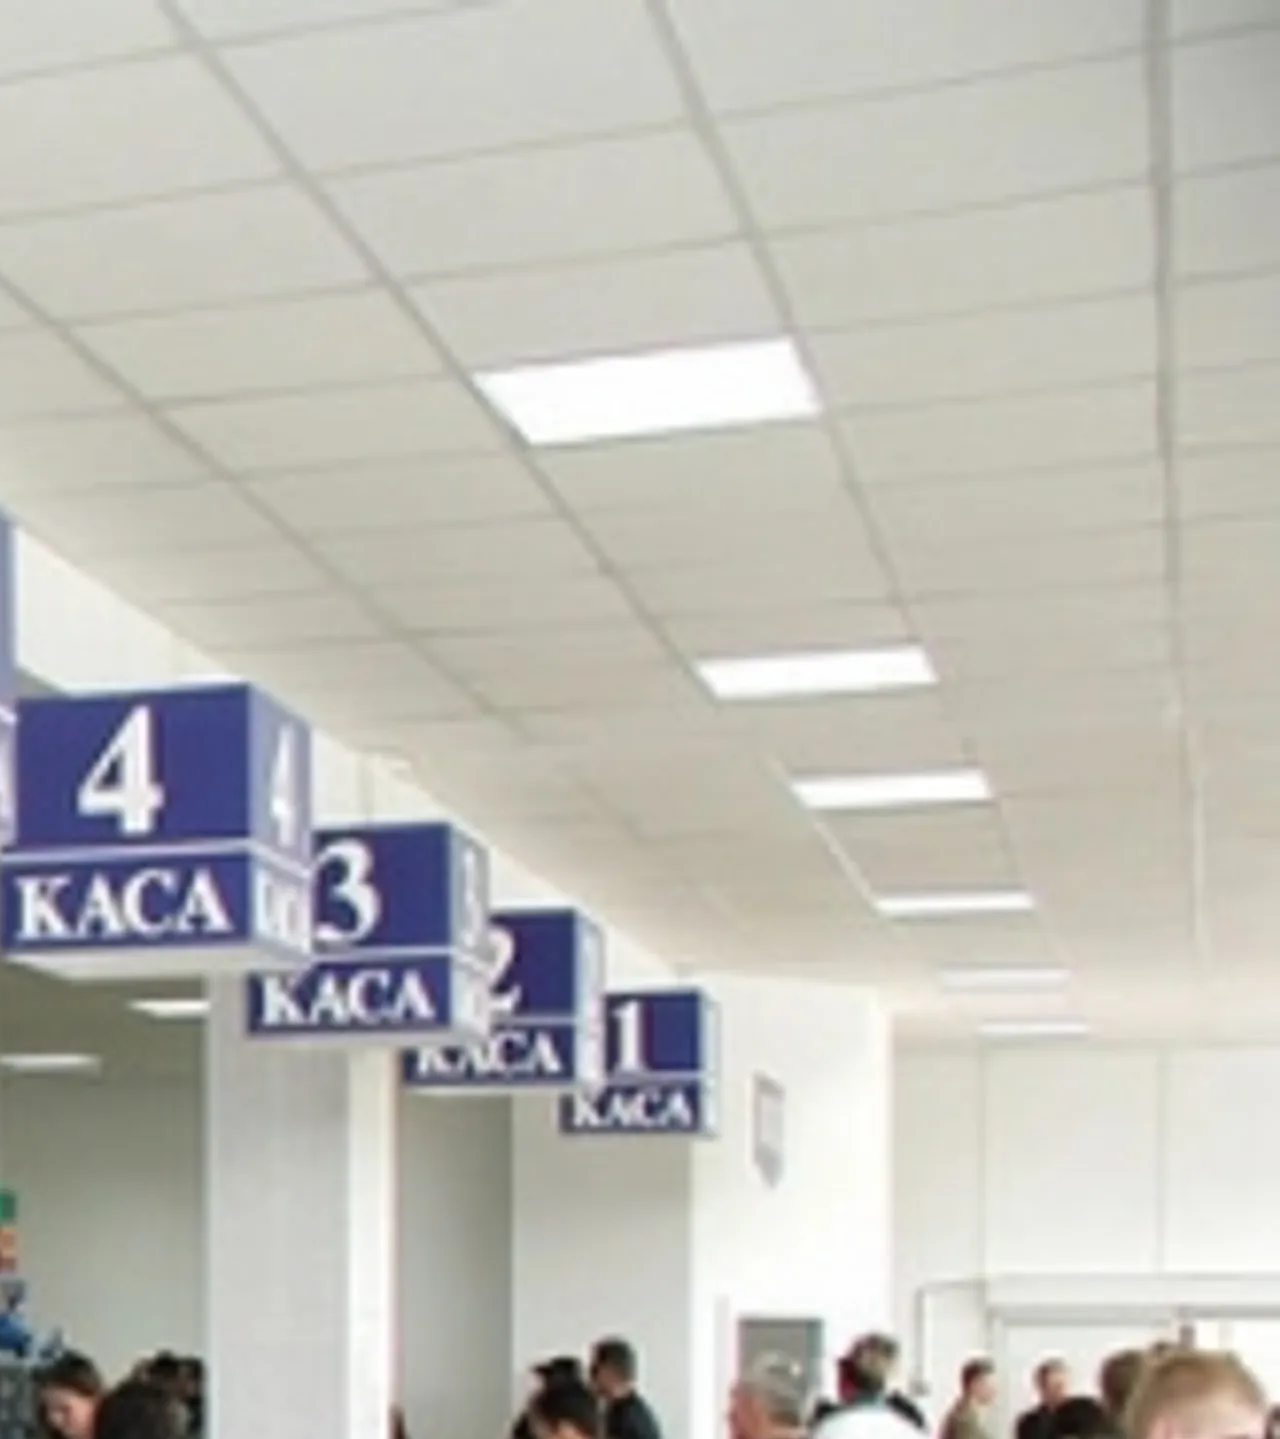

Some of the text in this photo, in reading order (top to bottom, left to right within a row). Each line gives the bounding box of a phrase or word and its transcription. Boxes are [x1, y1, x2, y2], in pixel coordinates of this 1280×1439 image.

[77, 705, 164, 835] 4
[15, 869, 233, 941] КАСА
[312, 838, 380, 943] 3
[262, 969, 436, 1026] КАСА
[612, 1001, 642, 1072] 1
